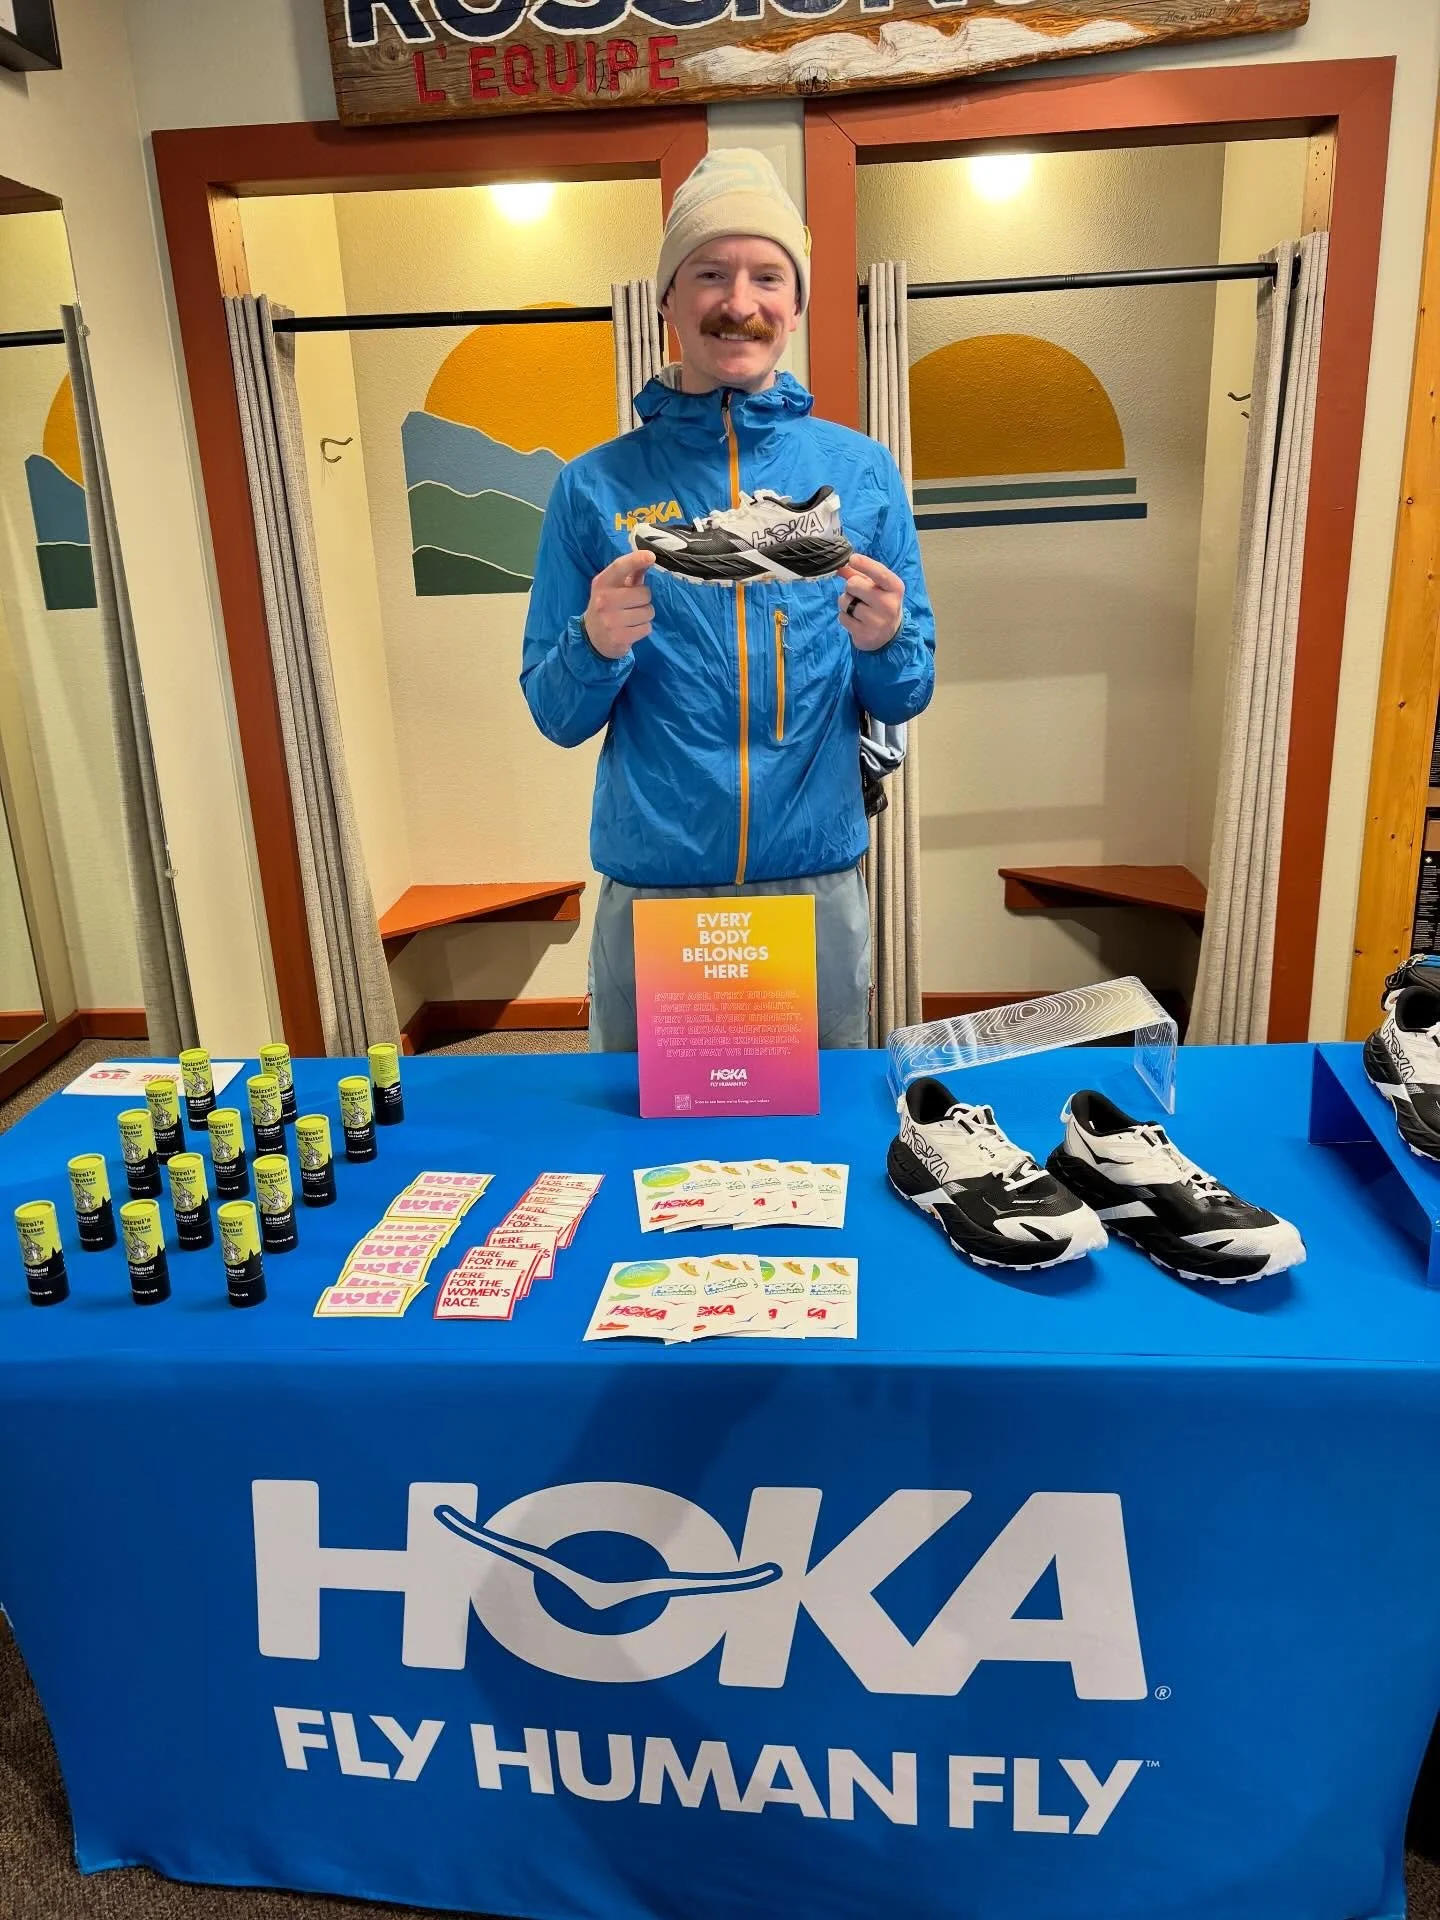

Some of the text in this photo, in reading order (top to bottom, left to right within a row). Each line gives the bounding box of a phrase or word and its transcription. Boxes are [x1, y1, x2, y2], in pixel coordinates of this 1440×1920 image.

[413, 35, 680, 104] L'EQUIPE
[615, 501, 684, 531] HOKA
[751, 511, 824, 550] HOKA
[697, 911, 752, 928] EVERY
[700, 929, 751, 945] BODY
[682, 946, 769, 962] BELONGS
[704, 964, 749, 979] HERE
[710, 1068, 748, 1080] HOKA
[492, 1236, 524, 1244] HERE
[472, 1250, 504, 1258] HERE
[468, 1258, 494, 1266] FOR
[496, 1258, 519, 1268] THE
[450, 1279, 503, 1288] FOR THE
[446, 1288, 511, 1298] WOMEN'S
[442, 1298, 480, 1308] RACE.
[273, 1706, 446, 1782] FLY
[469, 1722, 919, 1827] HUMAN
